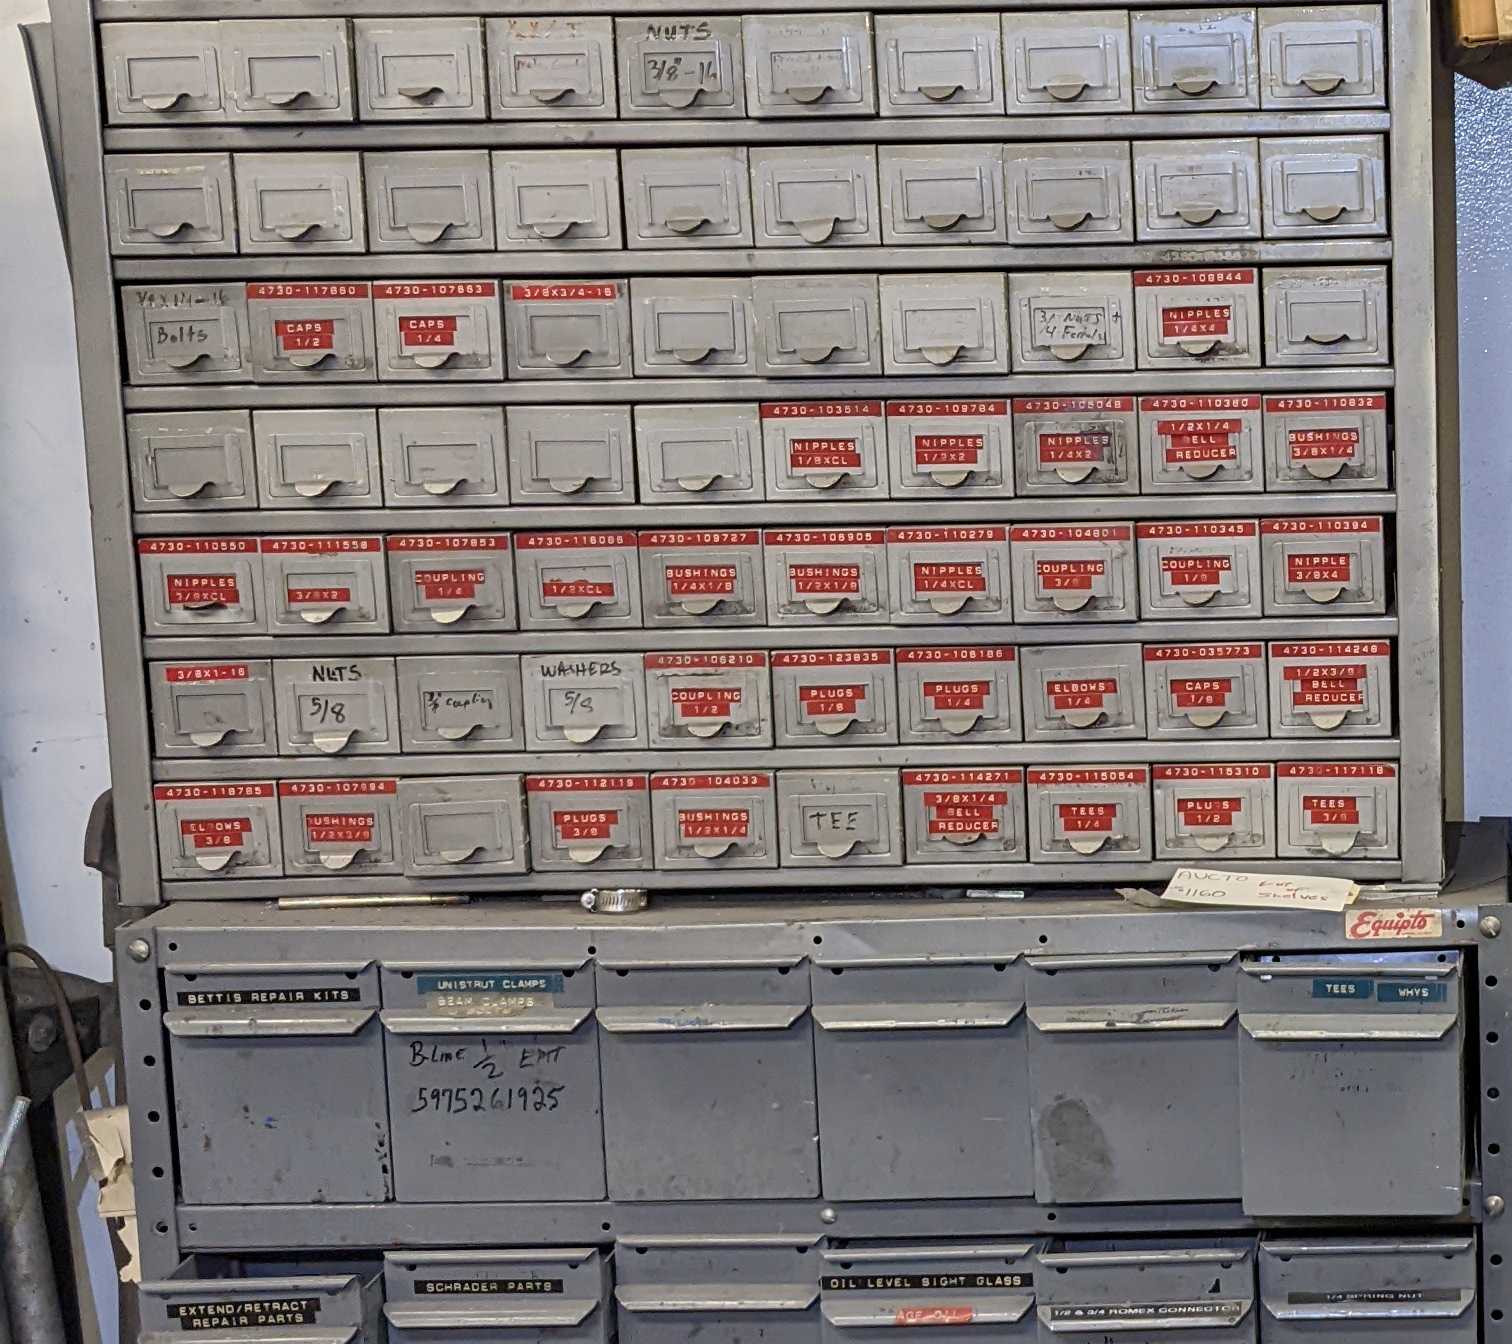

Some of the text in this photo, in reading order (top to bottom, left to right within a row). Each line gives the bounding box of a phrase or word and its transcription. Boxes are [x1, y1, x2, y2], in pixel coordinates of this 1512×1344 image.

[646, 22, 713, 41] NUTS
[1168, 308, 1230, 321] NIPPLES
[286, 322, 323, 335] CAPS
[408, 318, 446, 330] CAPS
[1047, 435, 1109, 447] NIPPLES
[1287, 430, 1360, 443] BUSHINGS
[793, 441, 856, 453] NIPPLES
[921, 437, 984, 449] NIPPLES
[1161, 558, 1231, 570] COUPLING
[1294, 556, 1347, 567] NIPPLE
[665, 567, 737, 578] BUSHINGS
[920, 565, 983, 576] NIPPLES
[173, 577, 235, 588] NIPPLES
[415, 572, 486, 583] COUPLING
[923, 579, 974, 590] 1/4XCL
[540, 662, 621, 676] WASHERS
[935, 683, 979, 694] PLUGS
[1053, 681, 1106, 694] ELBOWS
[1184, 680, 1221, 692] CAPS
[1311, 679, 1345, 690] BELL
[671, 690, 742, 702] COUPLING
[810, 688, 854, 699] PLUGS
[1310, 798, 1346, 810] TEES
[1070, 806, 1106, 818] TEES
[563, 813, 607, 824] PLUGS
[809, 810, 859, 831] TEE
[1350, 911, 1435, 938] Equipto
[436, 978, 548, 991] UNISTRUT CLAMPS
[1324, 982, 1356, 995] TEES
[187, 989, 350, 1005] BETTIS REPAIR KITS
[830, 1274, 1022, 1289] OIL LEVEL SIGHT GLASS
[425, 1281, 553, 1295] SCHRADER PARTS
[179, 1299, 309, 1317] EXTEND/RETRACT
[192, 1312, 305, 1329] REPAIR PARTS
